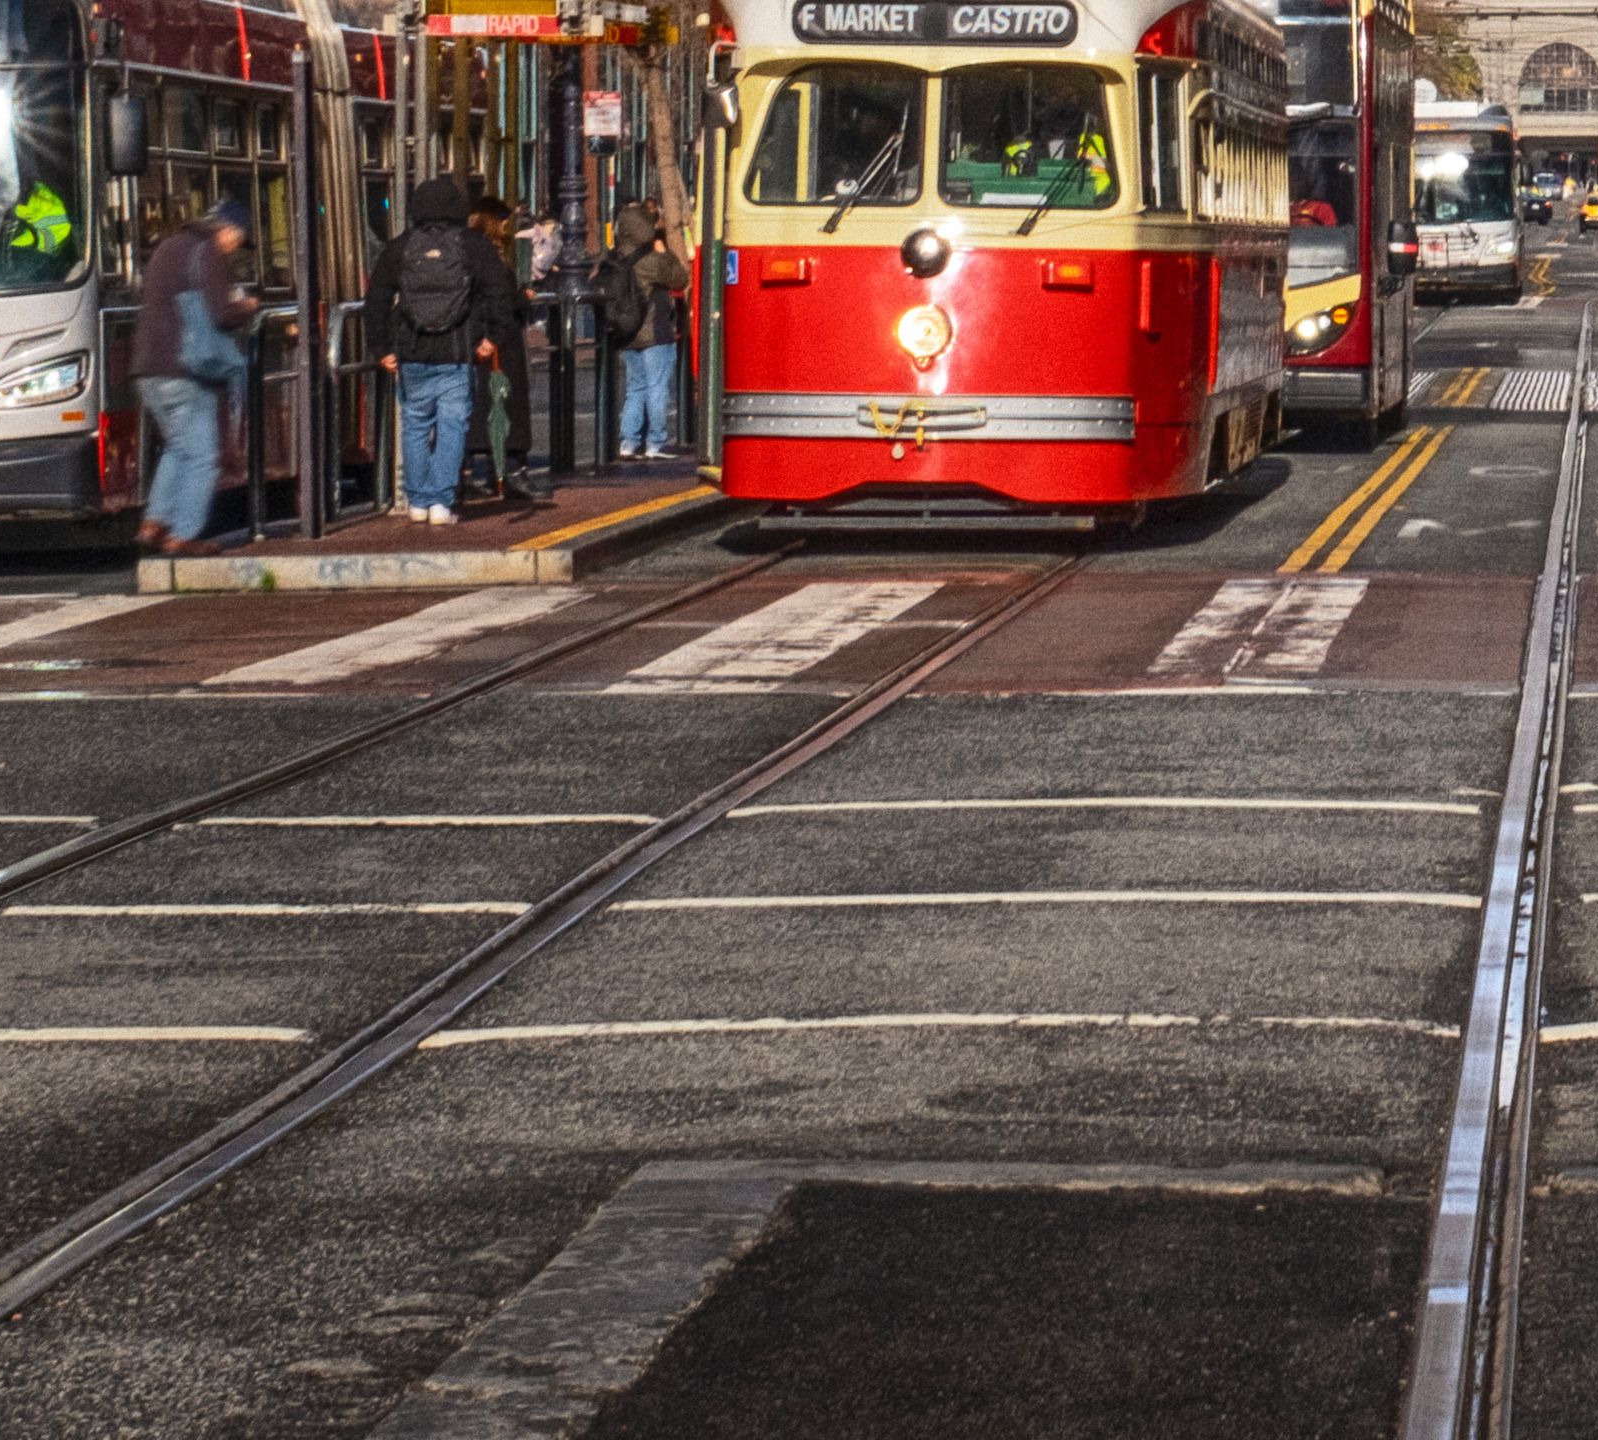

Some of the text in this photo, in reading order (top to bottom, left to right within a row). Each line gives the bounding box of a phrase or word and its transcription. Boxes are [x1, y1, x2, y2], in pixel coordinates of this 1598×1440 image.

[489, 16, 539, 34] RAPID
[802, 4, 1071, 34] F MARKET CASTRO
